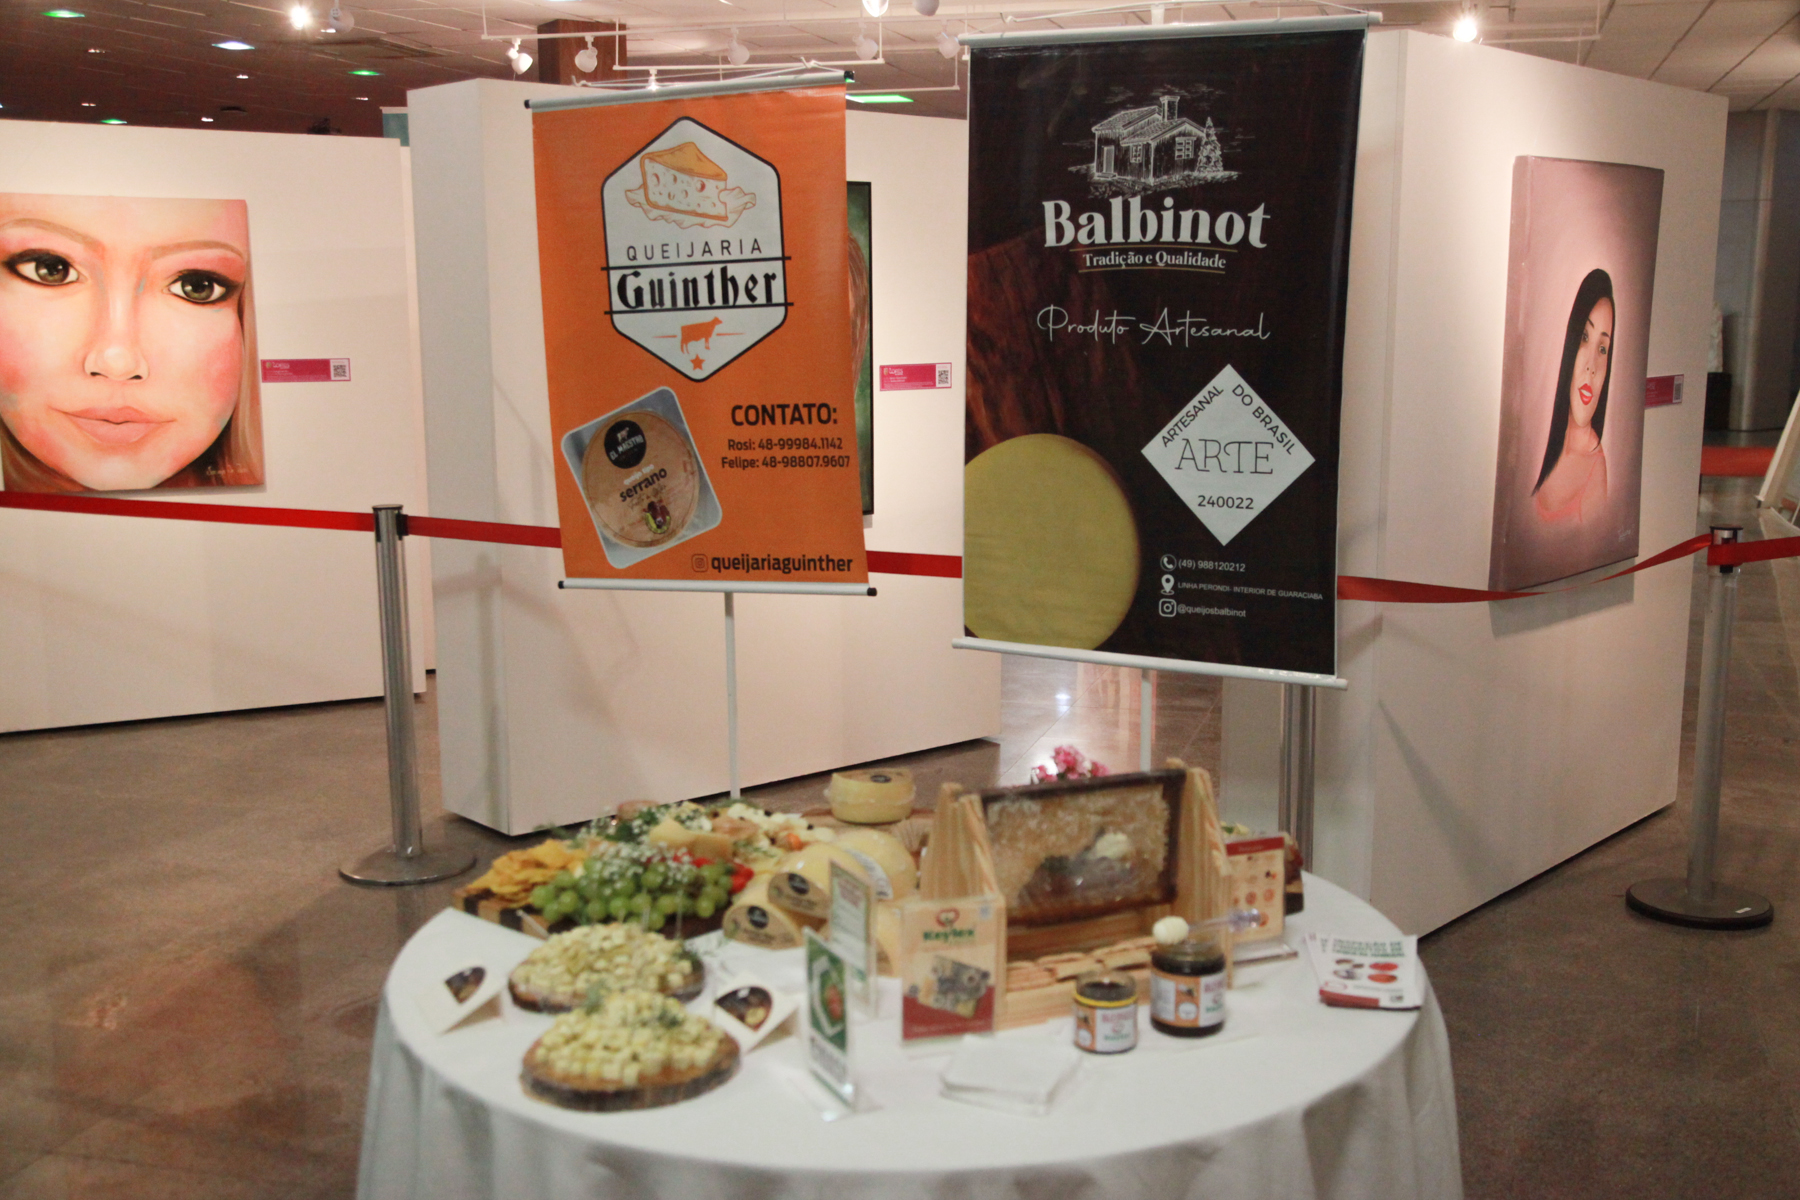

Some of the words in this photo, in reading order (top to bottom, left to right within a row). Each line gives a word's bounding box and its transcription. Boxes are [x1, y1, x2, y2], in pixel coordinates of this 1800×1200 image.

[1042, 195, 1271, 248] Balbinot
[627, 238, 762, 261] QUEIJARIA
[1083, 250, 1143, 269] Tradição
[1145, 253, 1153, 264] e
[1155, 250, 1226, 269] Qualidade
[617, 265, 777, 309] Guinther
[1037, 304, 1136, 345] Produto
[1139, 307, 1271, 347] Artesanal
[731, 403, 838, 426] CONTATO:
[1160, 385, 1224, 448] ARTESANAL
[1232, 384, 1253, 407] DO
[1252, 406, 1296, 455] BRASIL
[727, 439, 756, 451] Rosi:
[758, 437, 843, 450] 48-99984.1142
[721, 456, 760, 470] Felipe:
[762, 455, 850, 468] 48-98807.9607
[1174, 438, 1274, 475] ARTE
[619, 468, 667, 502] serrano
[1197, 495, 1255, 510] 240022
[711, 554, 853, 575] queijariaguinther
[1178, 559, 1196, 570] (49)
[1197, 560, 1246, 572] 988120212
[1177, 582, 1198, 590] LINHA
[1233, 586, 1266, 595] INTERIOR
[1266, 588, 1276, 596] DE
[1278, 590, 1323, 600] GUARACIABA
[1177, 603, 1247, 618] @queijosbalbinot
